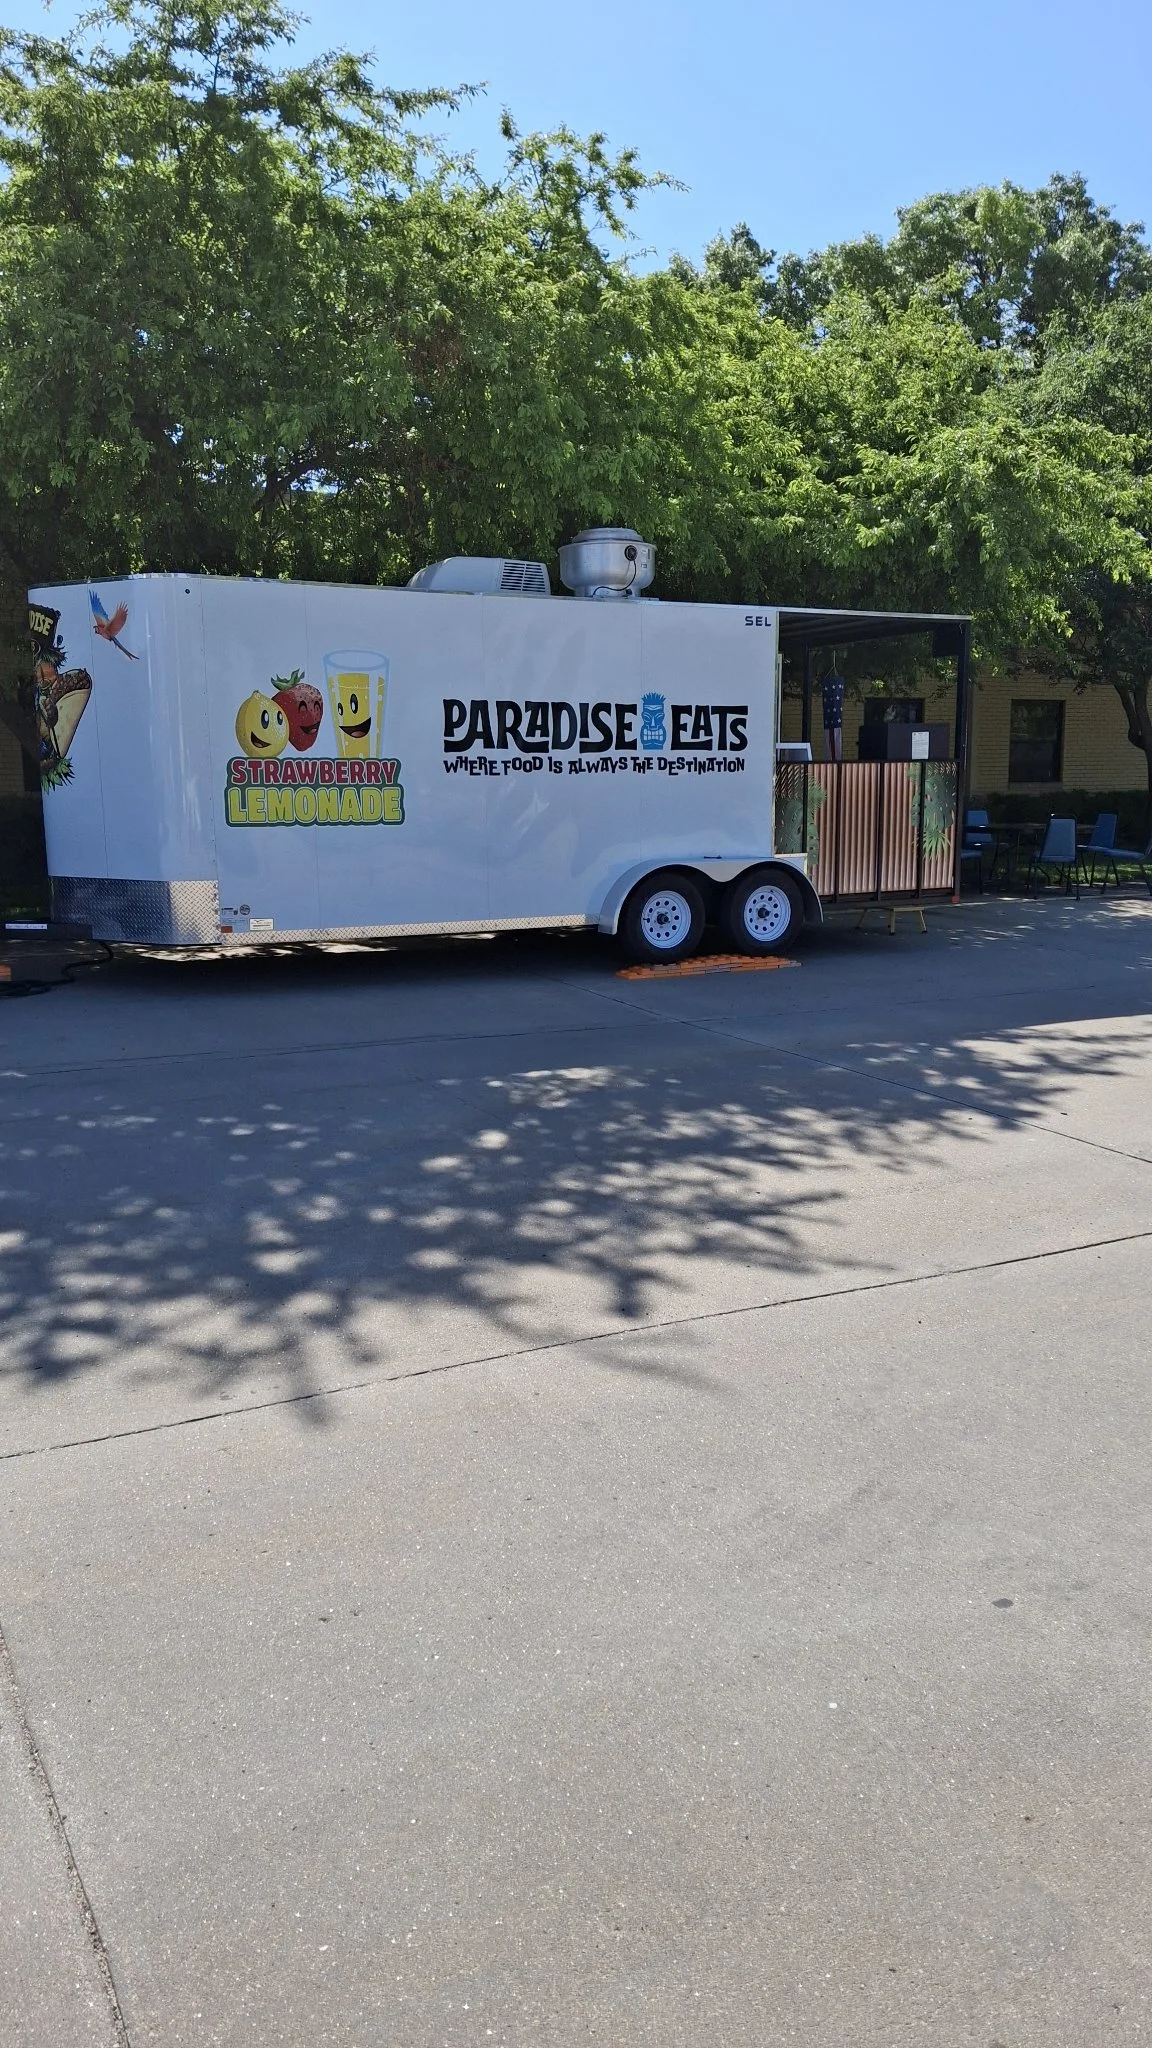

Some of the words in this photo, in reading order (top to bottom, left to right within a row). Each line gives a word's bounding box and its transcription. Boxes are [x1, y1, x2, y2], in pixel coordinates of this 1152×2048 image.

[745, 615, 772, 627] SEL
[443, 698, 638, 754] PARADISE
[670, 704, 749, 752] EATS
[230, 758, 397, 785] STRAWBERRY
[443, 756, 501, 776] WHERE
[501, 756, 544, 776] FOOD
[548, 756, 563, 774] IS
[568, 757, 628, 774] ALWAYS
[630, 757, 654, 774] THE
[657, 757, 745, 776] DESTINATION
[228, 787, 402, 824] LEMONADE
